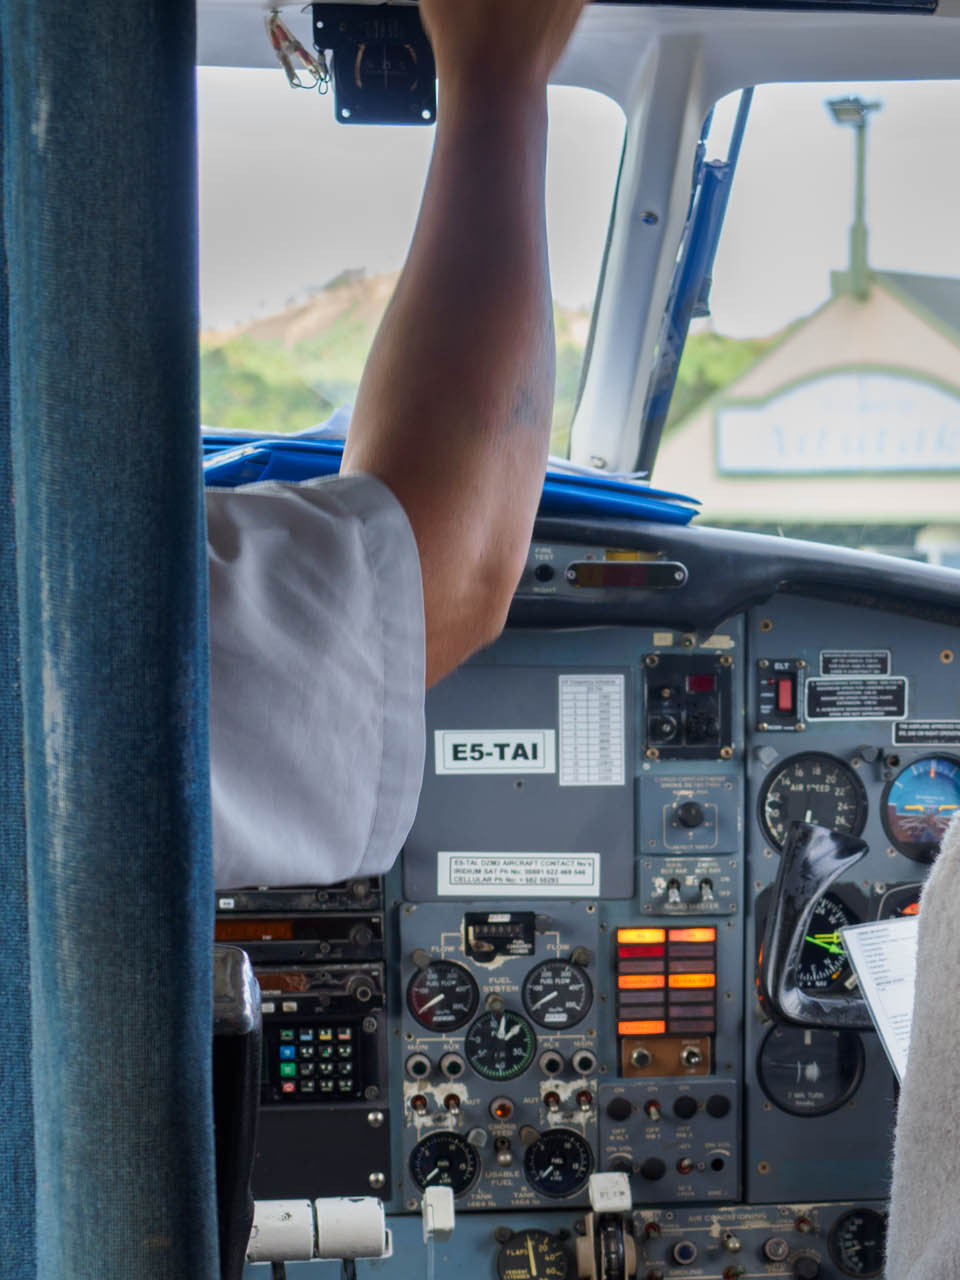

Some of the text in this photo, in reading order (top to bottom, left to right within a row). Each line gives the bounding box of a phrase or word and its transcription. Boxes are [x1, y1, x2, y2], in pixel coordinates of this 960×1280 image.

[774, 662, 790, 670] ELT
[452, 743, 538, 762] E5-TAI
[790, 784, 831, 792] AIR SEED
[506, 1248, 529, 1256] FLAPS
